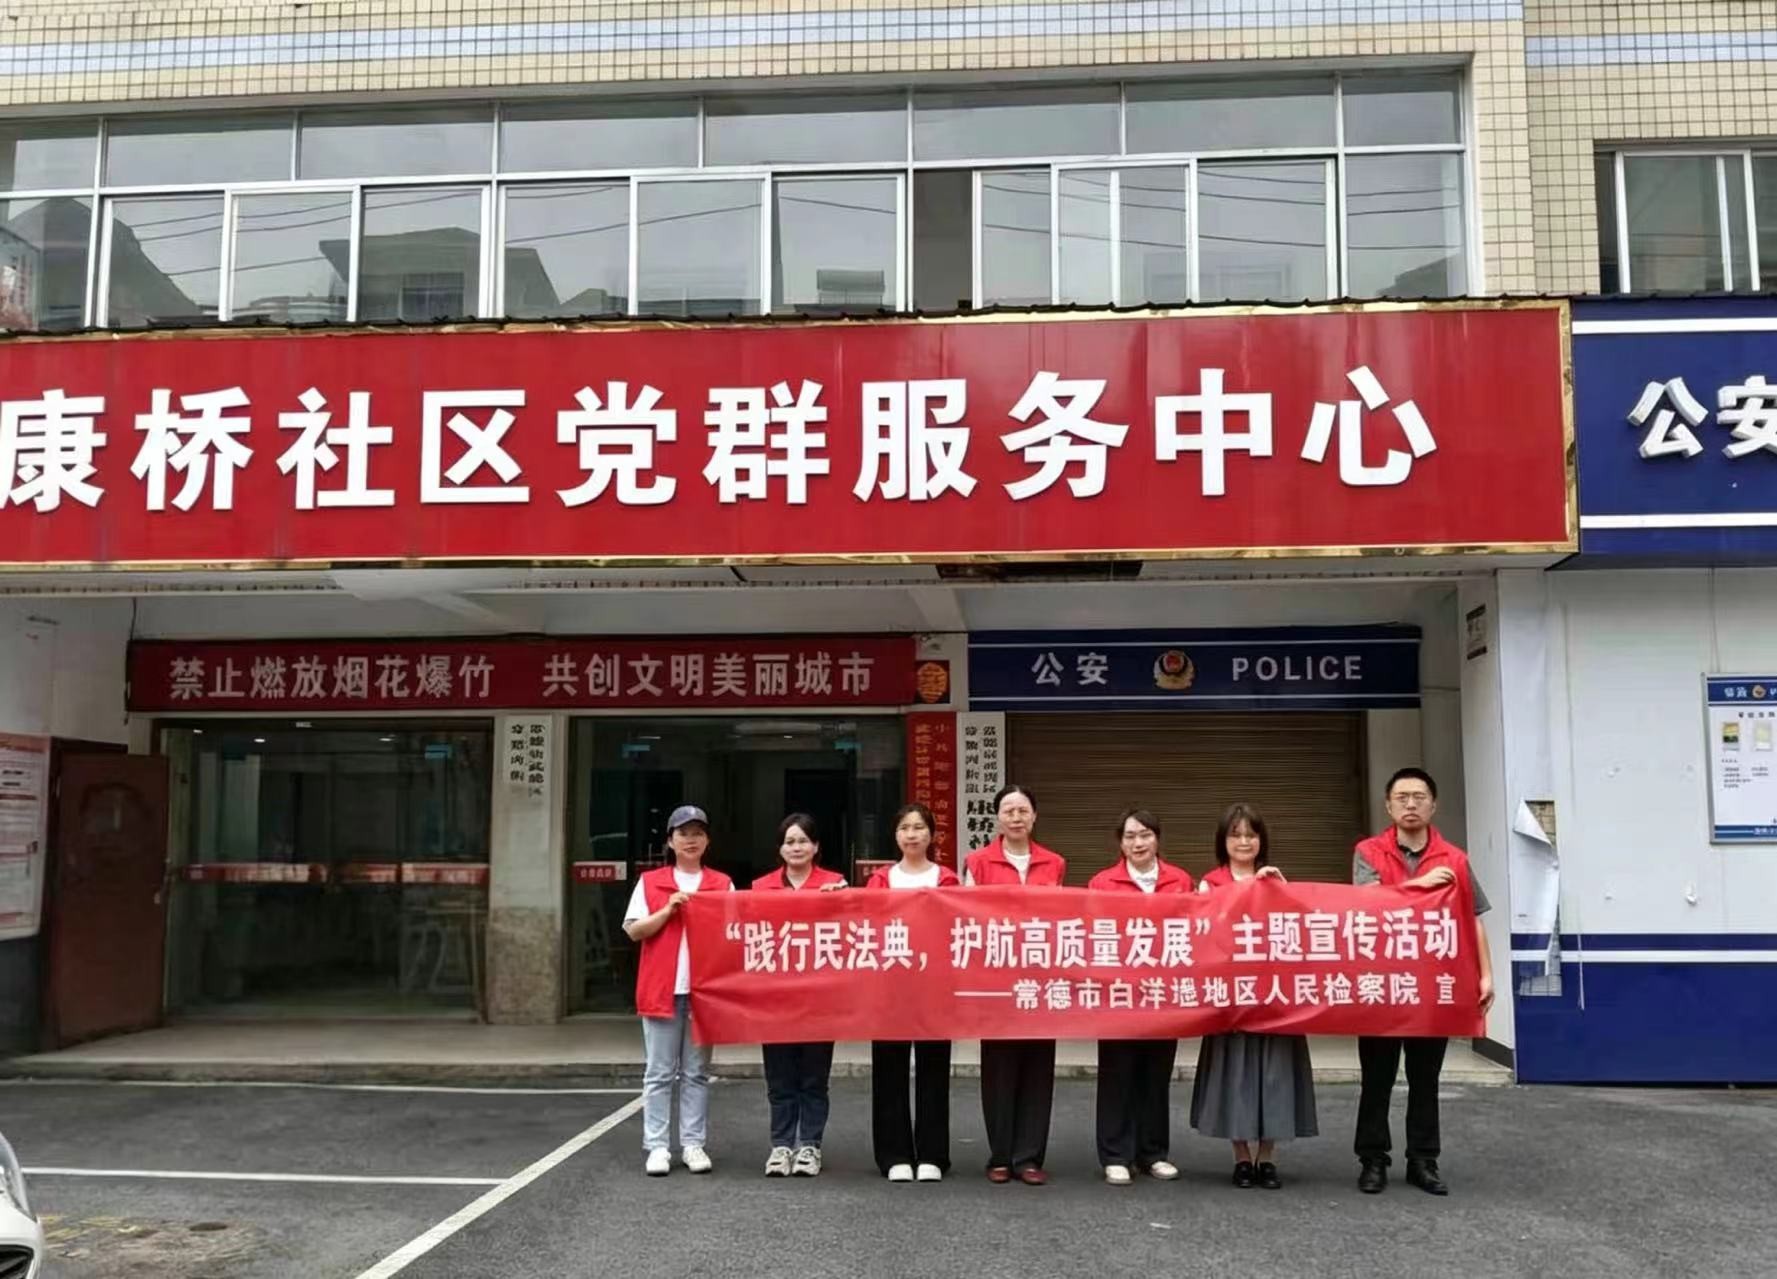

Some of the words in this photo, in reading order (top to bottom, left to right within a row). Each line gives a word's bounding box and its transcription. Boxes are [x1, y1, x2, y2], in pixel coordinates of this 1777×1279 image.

[0, 364, 1437, 512] 康桥社区党群服务中心
[1627, 375, 1777, 459] 公安
[169, 654, 495, 700] 禁止燃放烟花爆竹
[542, 651, 875, 697] 共创文明美丽城市
[1031, 652, 1109, 686] 公安
[1231, 655, 1363, 681] POLICE
[1232, 907, 1459, 962] 主题宣传活动
[1436, 973, 1457, 1005] 宣
